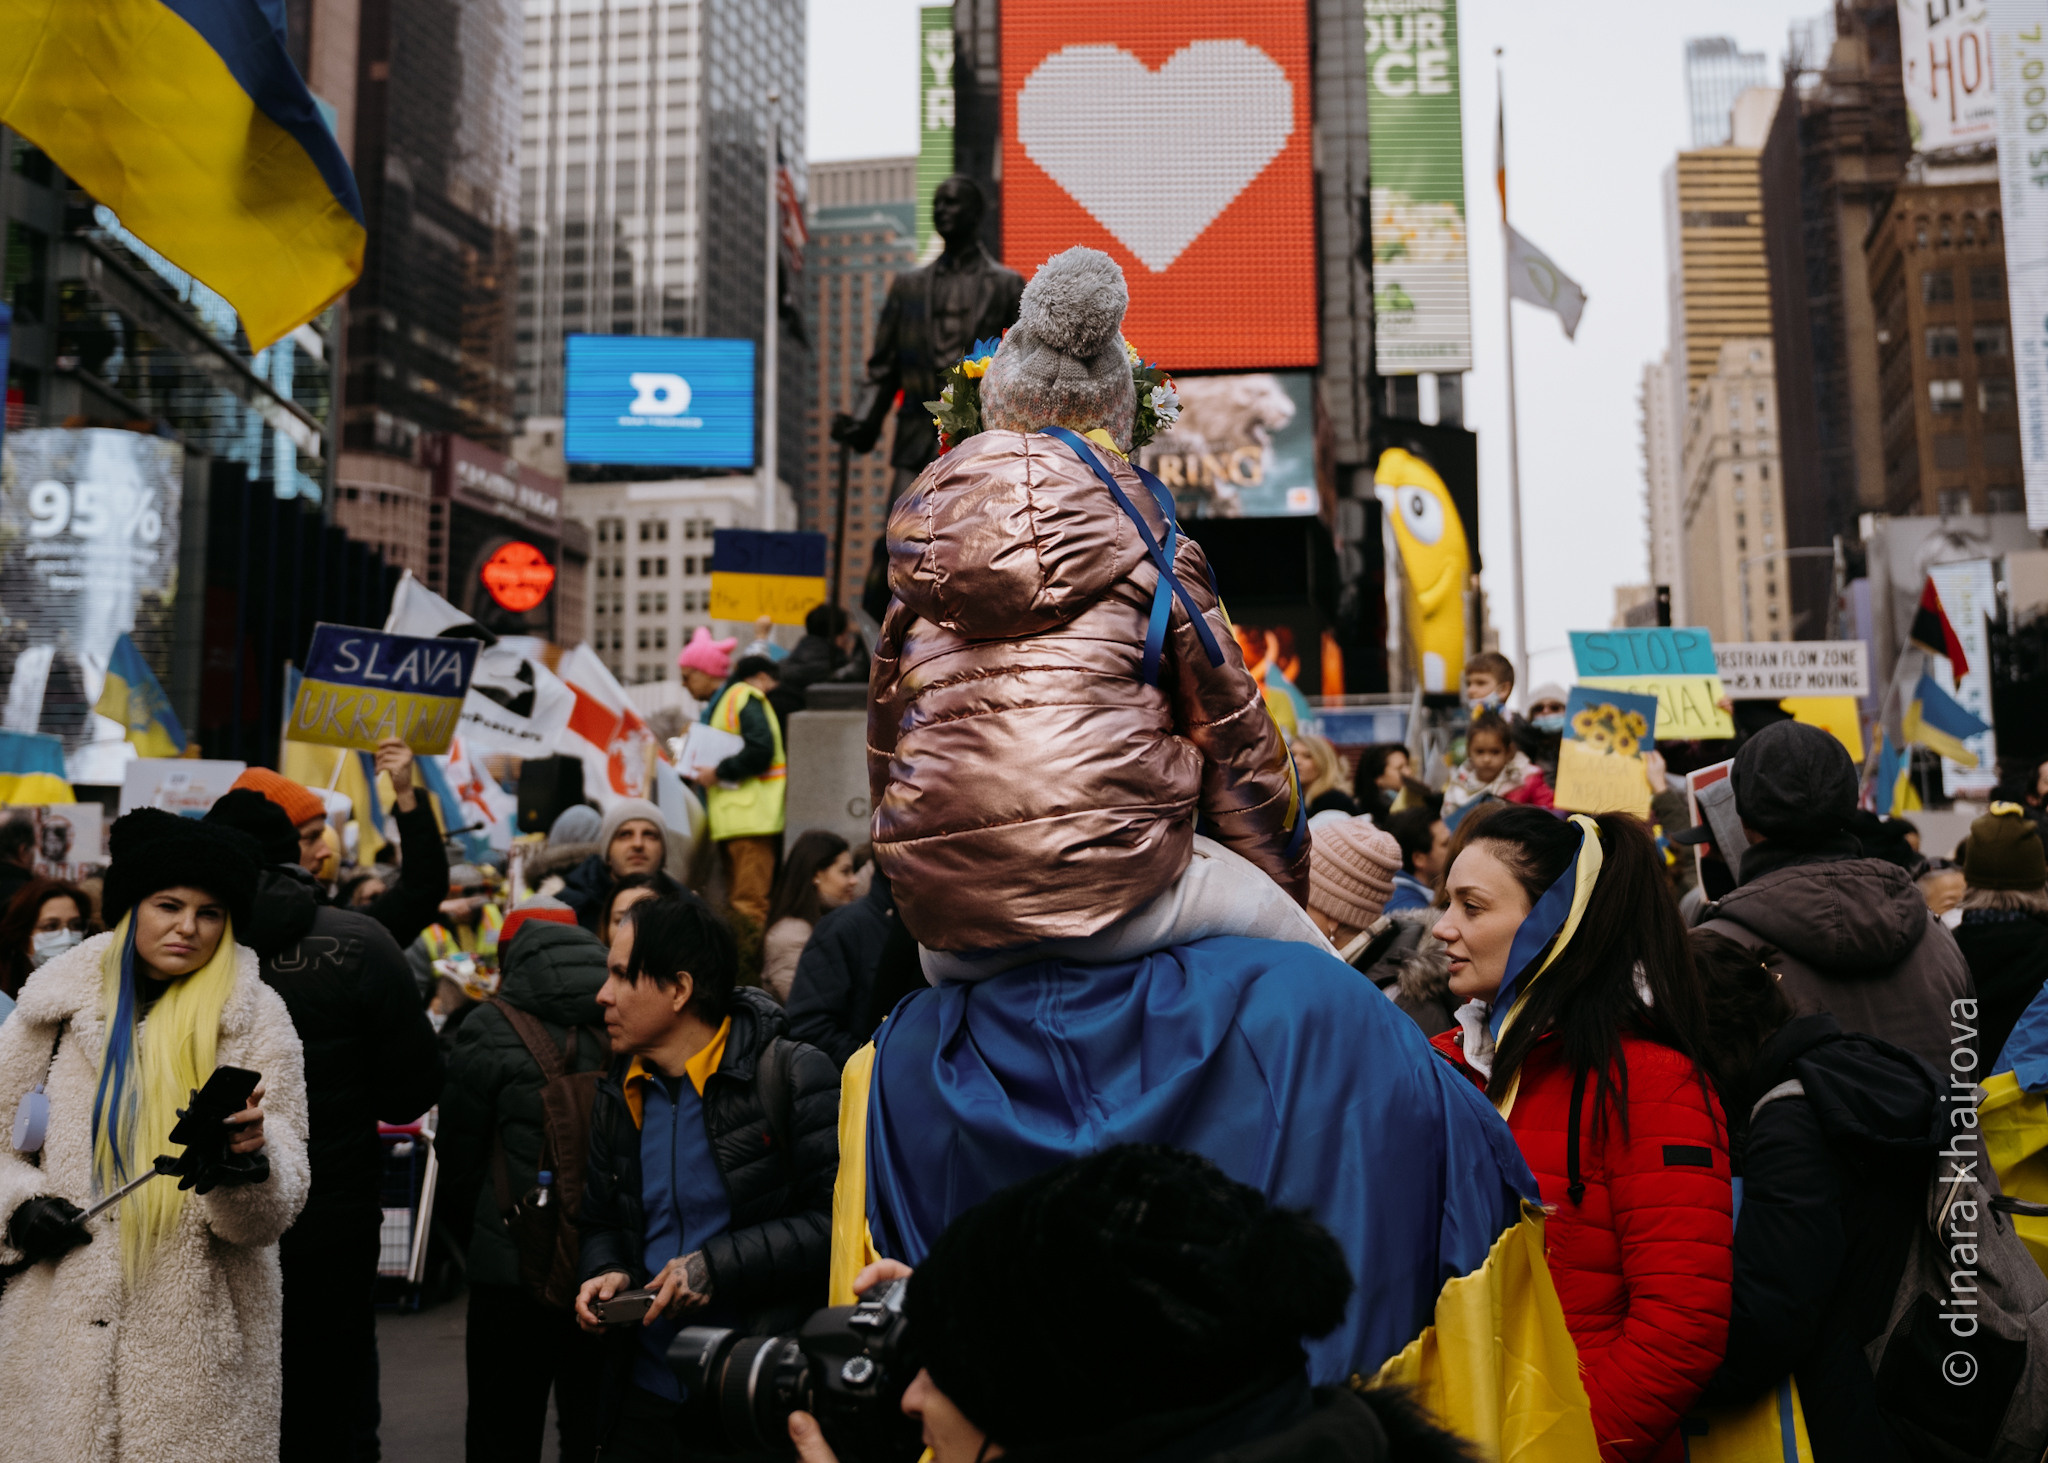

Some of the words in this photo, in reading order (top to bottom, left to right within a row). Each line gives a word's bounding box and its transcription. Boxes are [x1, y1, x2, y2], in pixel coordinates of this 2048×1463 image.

[1364, 13, 1446, 53] OUR
[29, 480, 162, 543] 95%
[333, 638, 463, 688] SLAVA
[1585, 631, 1697, 673] STOP
[1714, 651, 1777, 669] DESTRIAN
[1782, 651, 1817, 668] FLOW
[1822, 648, 1858, 667] ZONE
[1769, 672, 1801, 690] KEEP
[1806, 670, 1859, 690] MOVING
[299, 690, 454, 744] UKRAINI
[1627, 680, 1722, 728] SIA!
